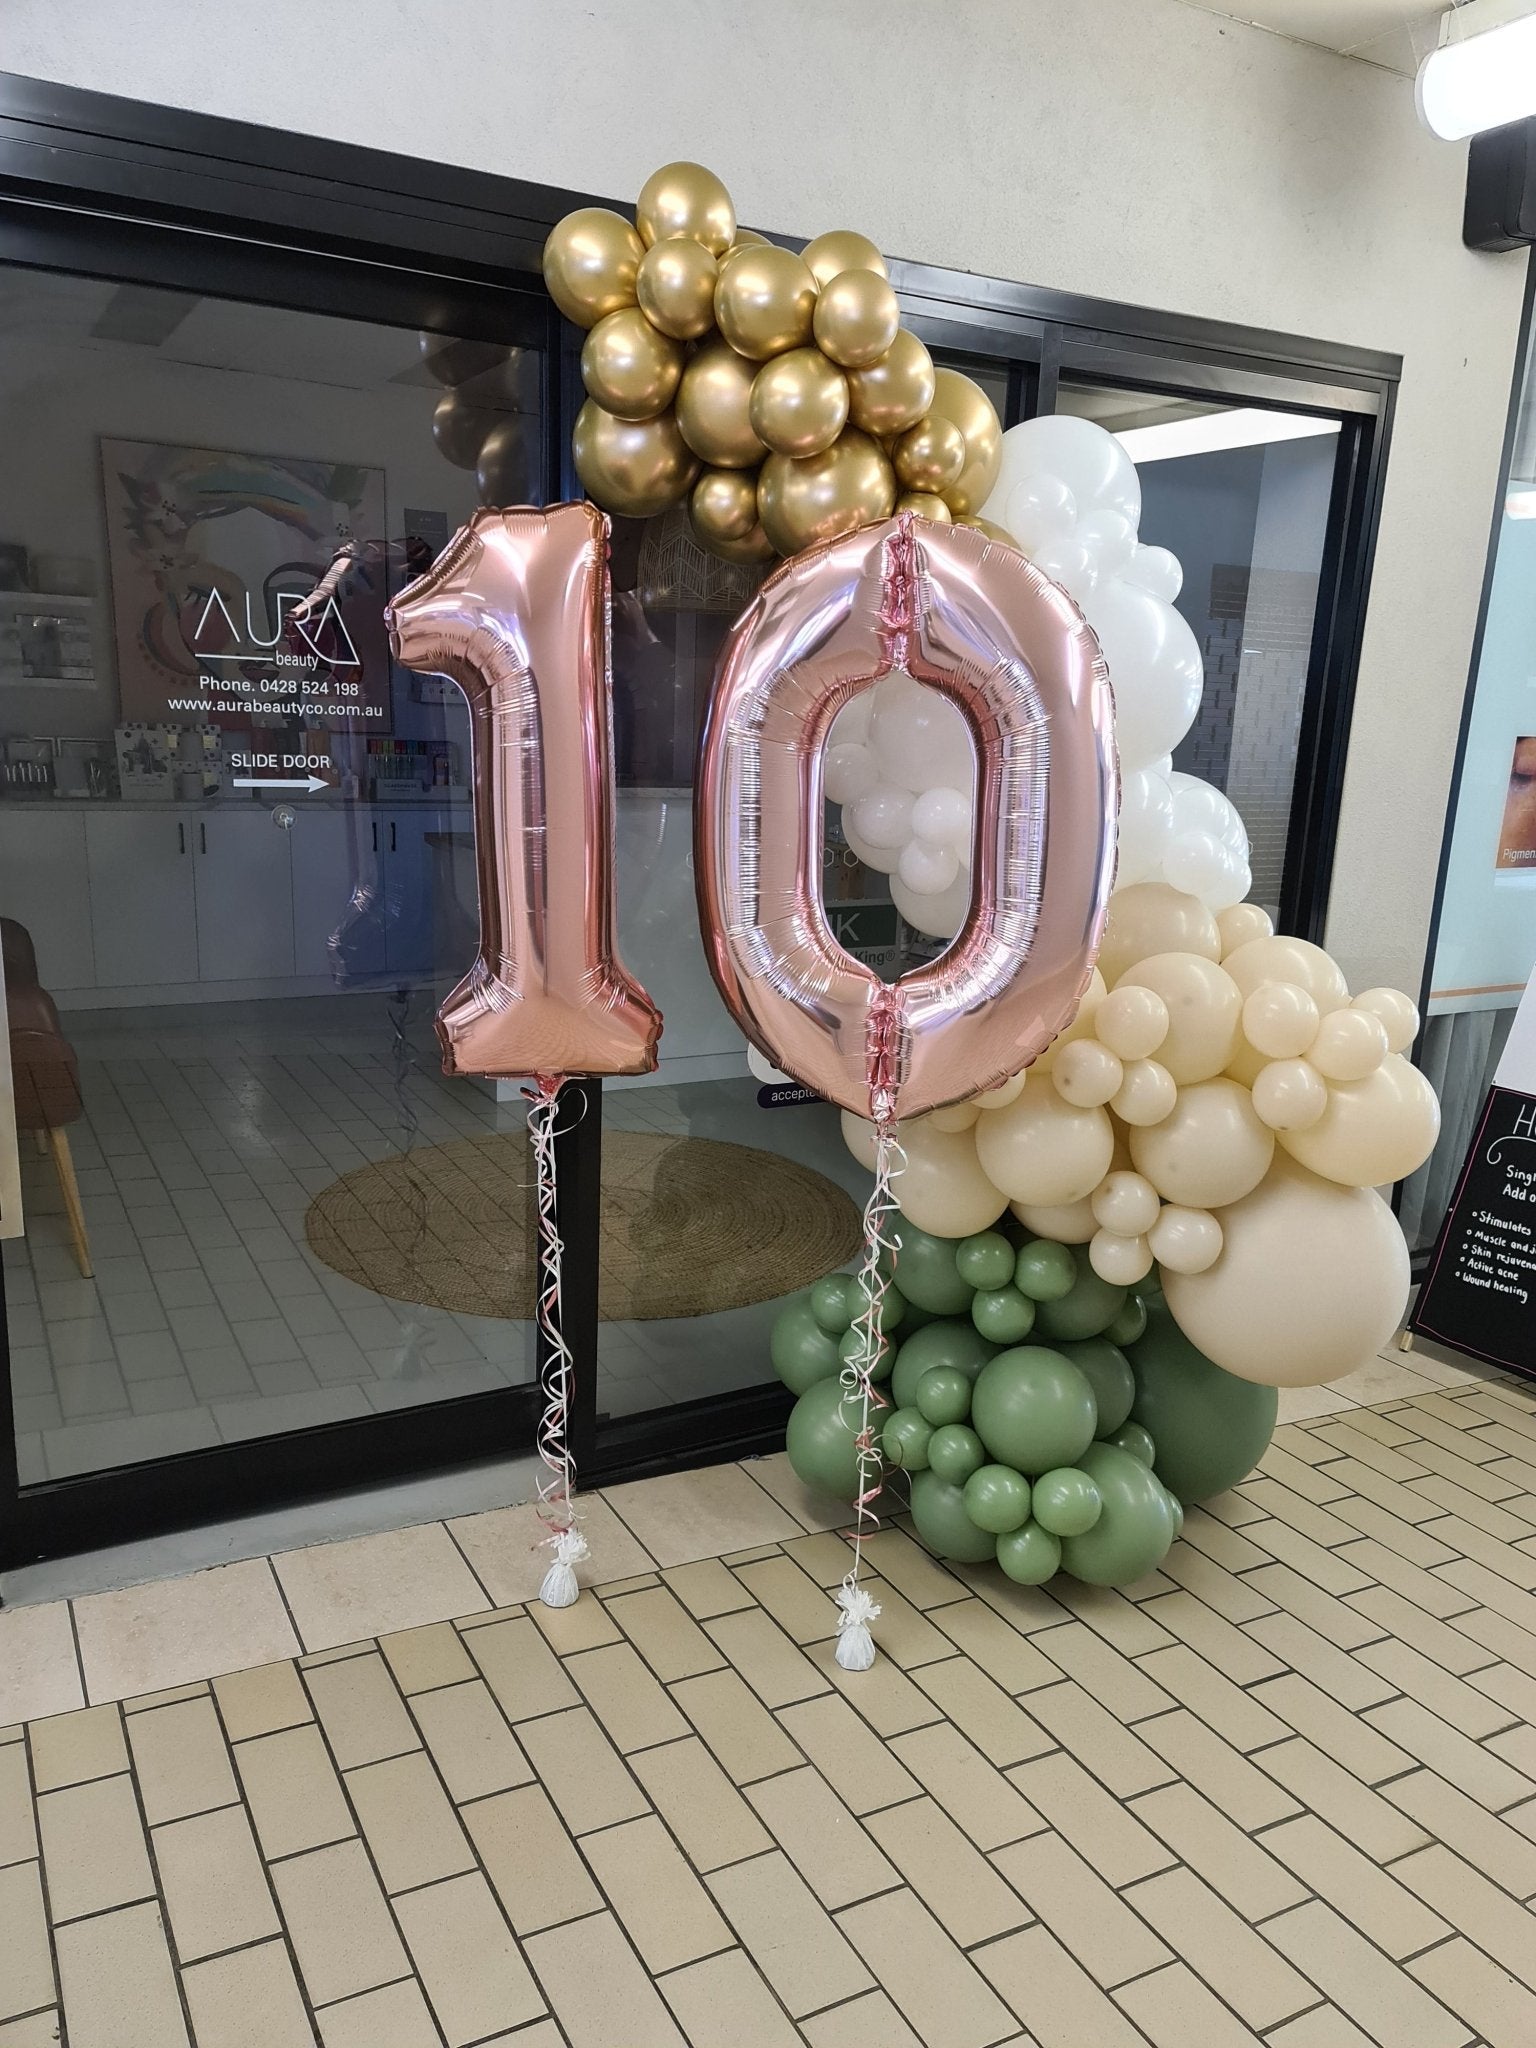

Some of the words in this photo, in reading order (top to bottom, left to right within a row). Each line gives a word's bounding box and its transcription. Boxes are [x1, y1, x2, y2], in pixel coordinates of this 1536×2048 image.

[194, 586, 360, 665] AURA
[275, 650, 319, 671] beauty
[199, 676, 255, 692] Phone.
[260, 679, 296, 694] 0428
[301, 681, 329, 695] 524
[334, 681, 359, 696] 198
[168, 698, 383, 718] www.aurabeautyco.com.au
[231, 753, 278, 768] SLIDE
[283, 754, 331, 769] DOOR
[1512, 1103, 1536, 1137] H
[1502, 1183, 1527, 1201] Add
[1478, 1210, 1532, 1236] Stimulates
[1471, 1244, 1492, 1258] Skin
[1474, 1230, 1507, 1247] Muscle
[1510, 1241, 1529, 1253] and
[1467, 1258, 1494, 1274] Active
[1497, 1268, 1519, 1281] acne
[1462, 1271, 1491, 1288] Wound
[1493, 1280, 1529, 1304] healing
